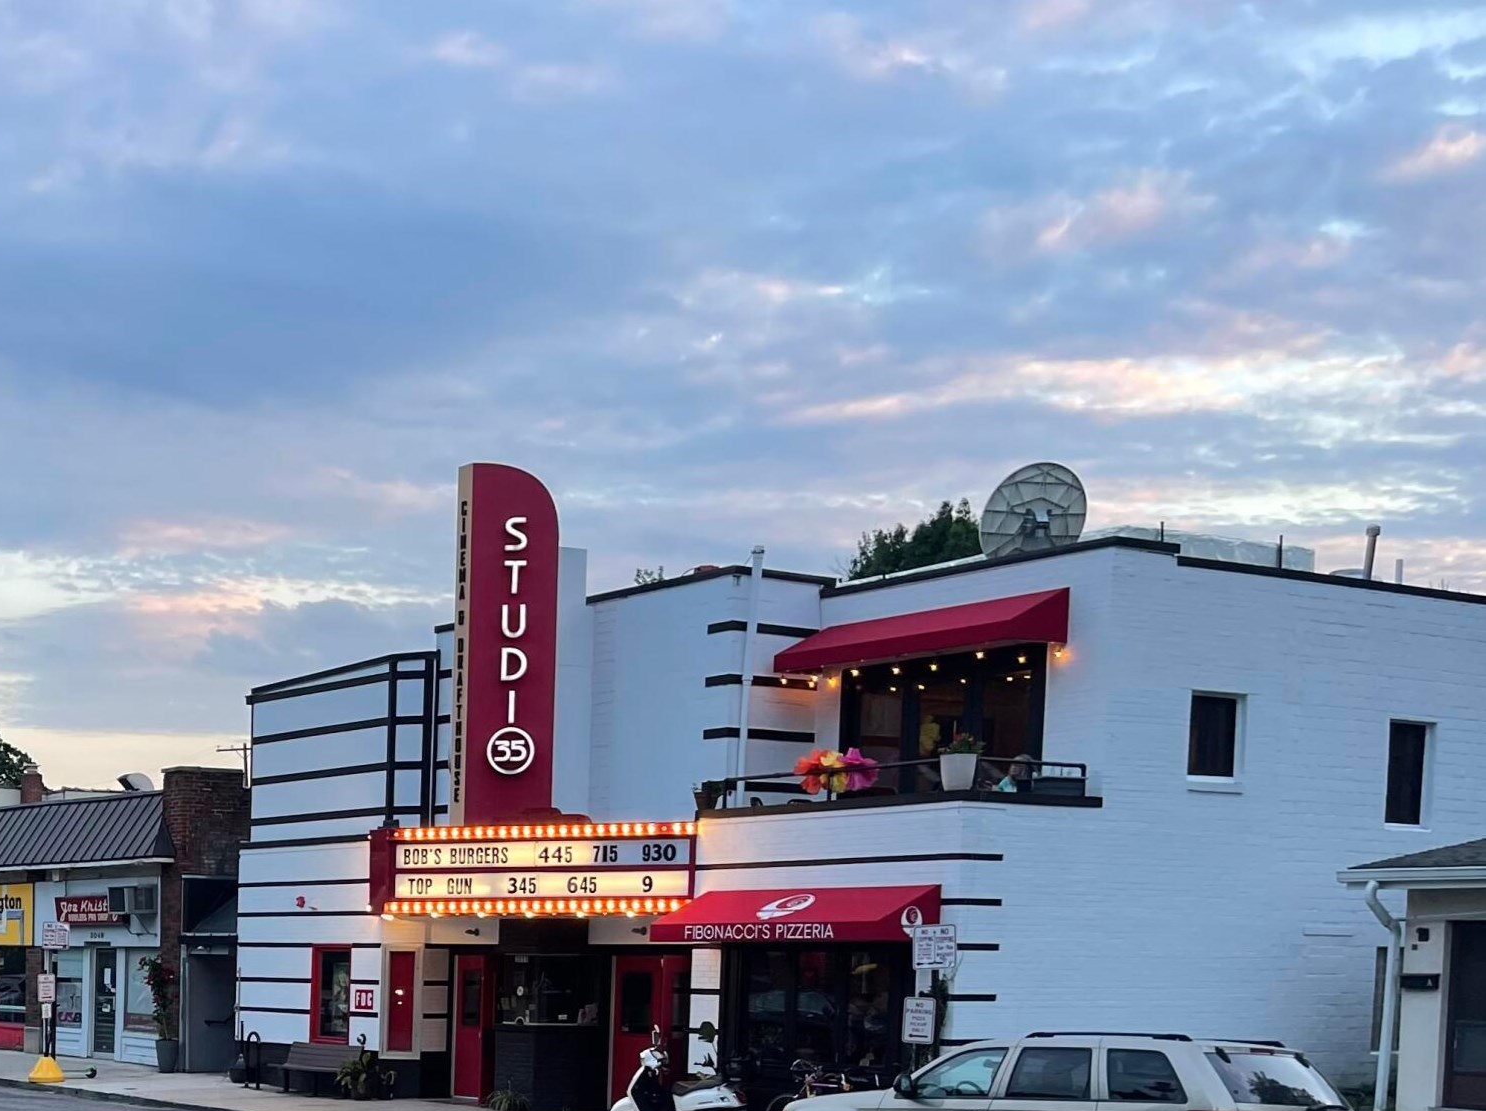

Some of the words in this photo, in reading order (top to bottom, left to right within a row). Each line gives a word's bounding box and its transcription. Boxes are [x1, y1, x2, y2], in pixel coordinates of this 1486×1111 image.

[458, 500, 468, 600] CINEMA
[454, 638, 464, 803] DRAFTHOUSE
[493, 739, 528, 762] 35
[403, 847, 442, 865] BOB'S
[449, 847, 509, 864] BURGERS
[538, 846, 573, 863] 445
[592, 845, 618, 863] 715
[642, 844, 677, 862] 930
[408, 878, 432, 895] TOP
[447, 878, 473, 894] GUN
[507, 877, 537, 894] 345
[567, 877, 597, 894] 645
[641, 876, 654, 892] 9
[60, 902, 79, 921] Joe
[684, 924, 771, 939] FIBONACCI'S
[775, 924, 834, 939] PIZZERIA
[940, 927, 949, 935] NO
[1426, 978, 1433, 986] A
